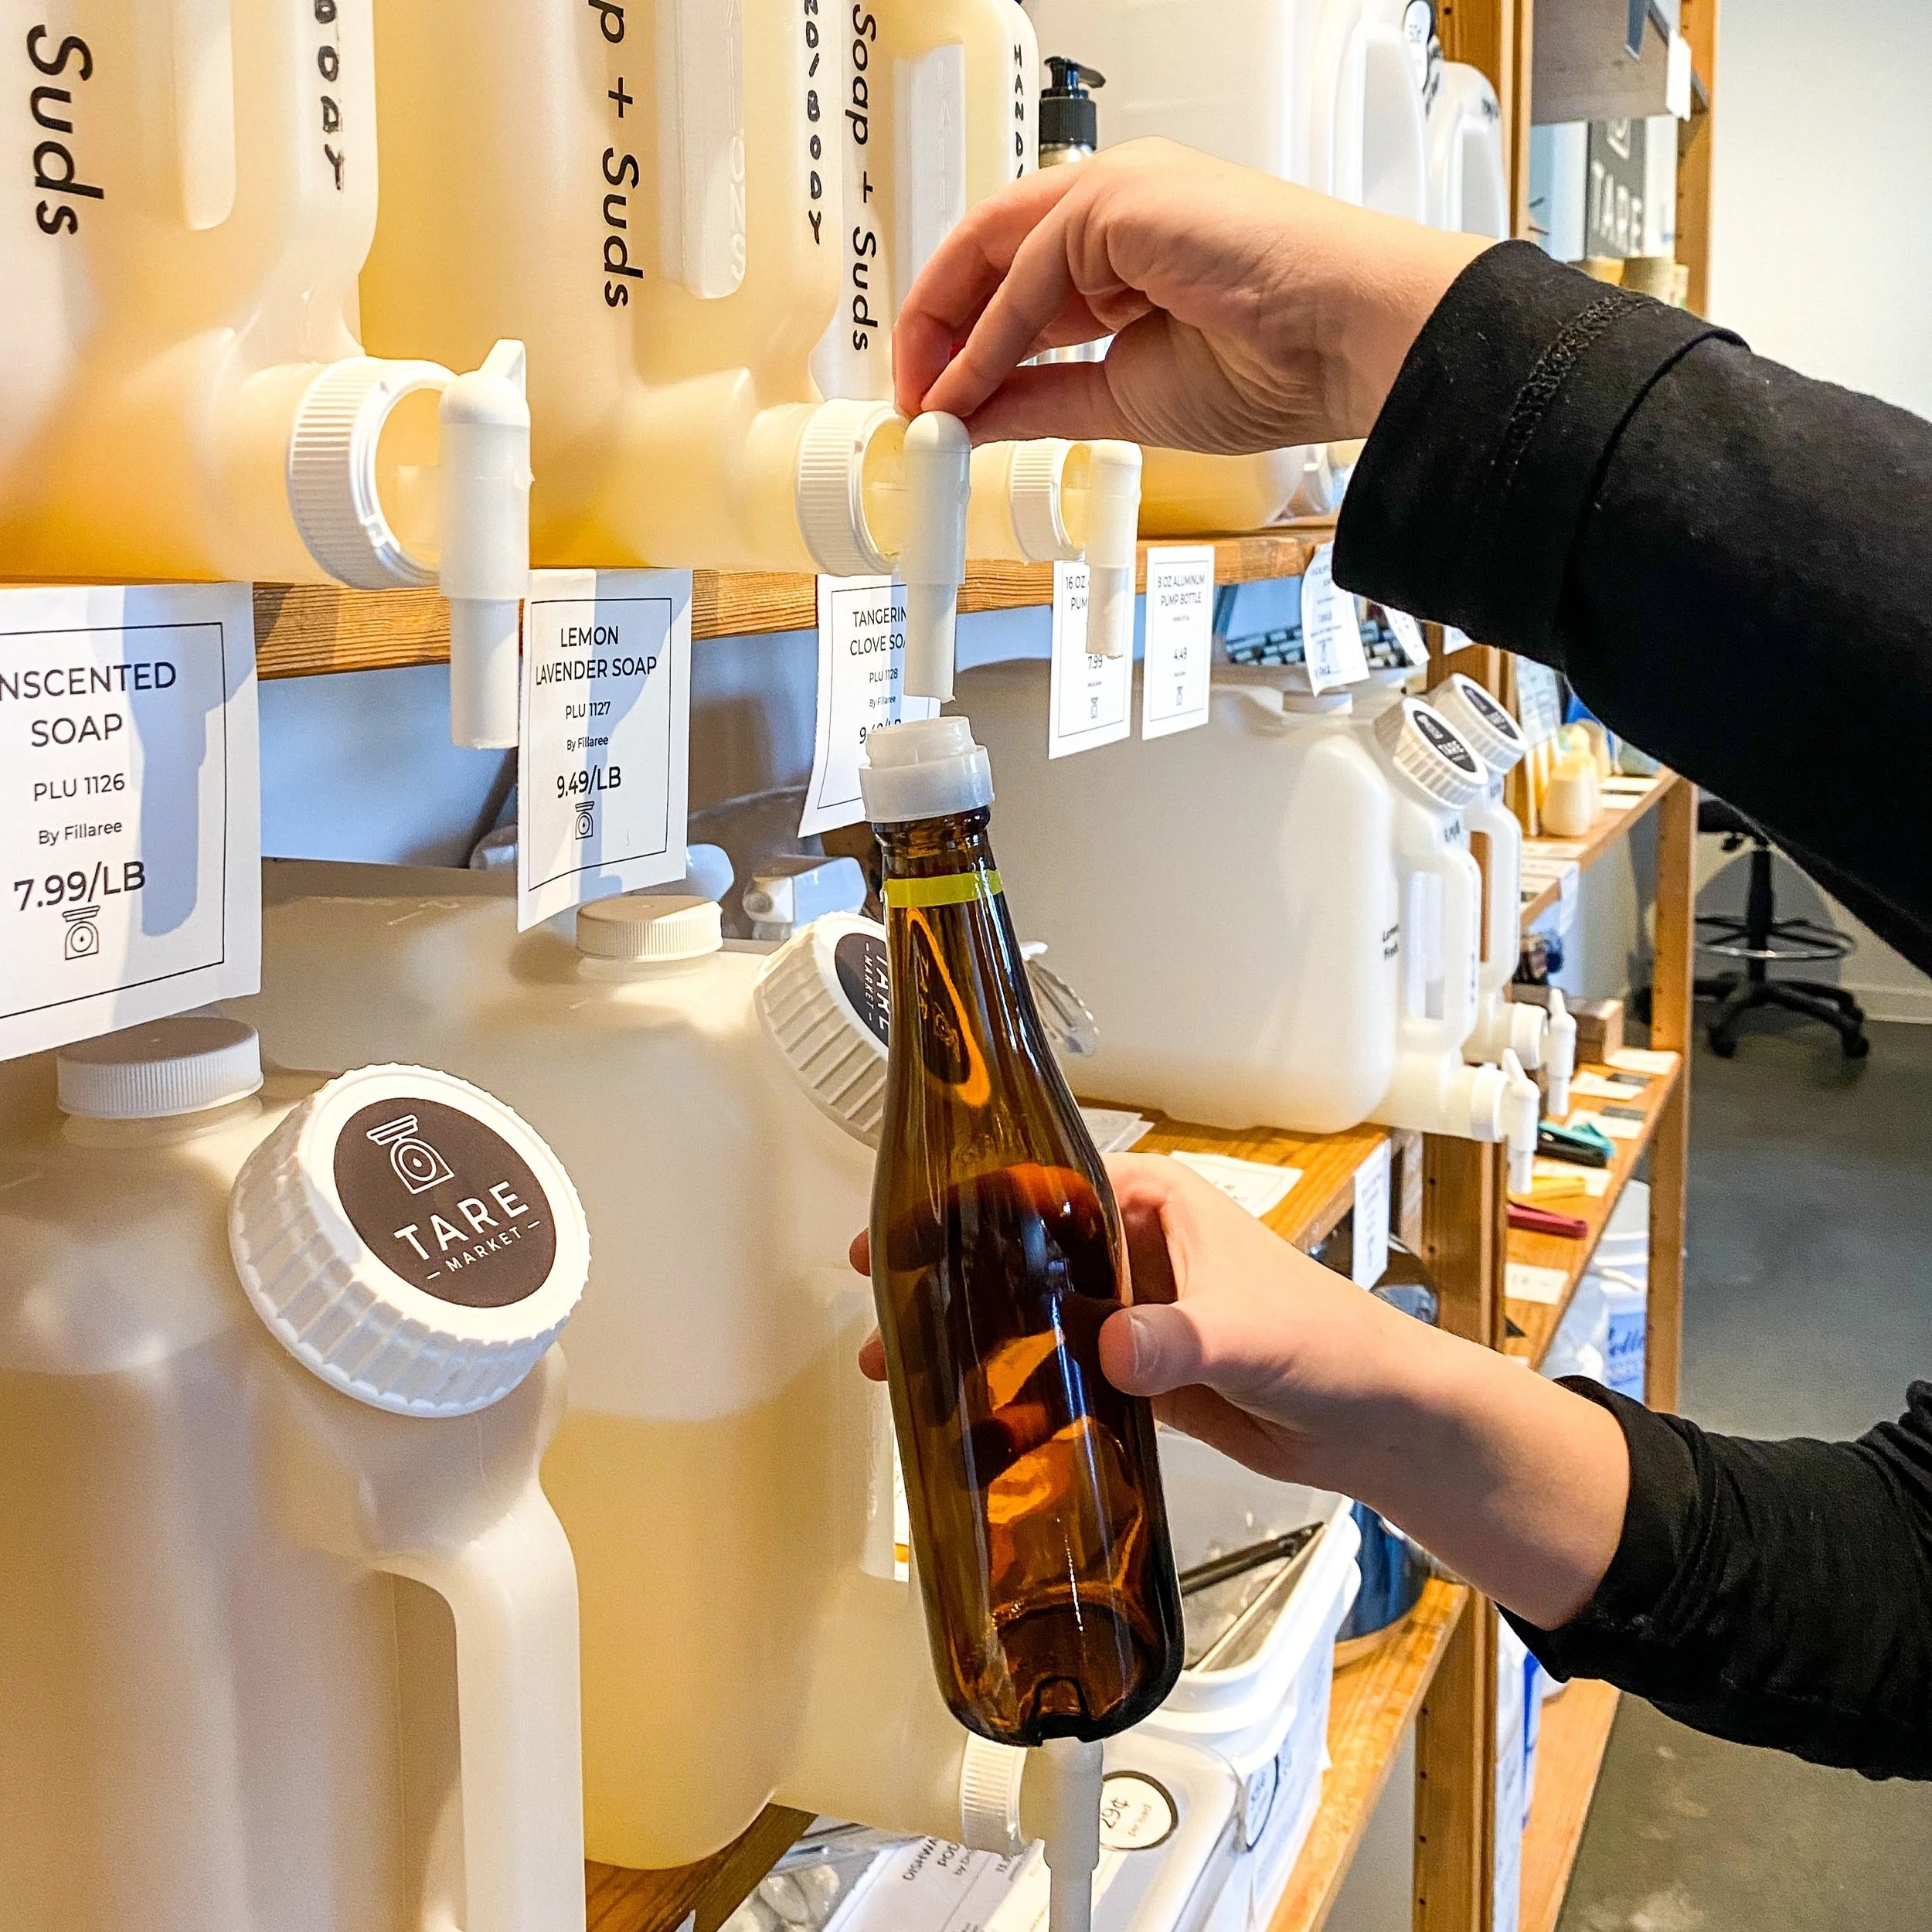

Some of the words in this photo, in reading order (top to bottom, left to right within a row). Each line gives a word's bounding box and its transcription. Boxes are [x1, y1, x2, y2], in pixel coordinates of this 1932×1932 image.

[845, 4, 877, 145] Soap
[27, 24, 104, 235] Suds
[602, 148, 644, 308] Suds
[852, 226, 879, 351] Suds
[1066, 577, 1073, 590] 16
[1076, 576, 1086, 589] OZ
[1163, 576, 1172, 588] OZ
[1173, 574, 1205, 587] ALUMINUM
[1070, 597, 1087, 611] PUM
[1161, 594, 1179, 607] PUMP
[1180, 592, 1202, 605] BOTTLE
[852, 606, 906, 628] TANGERIN
[561, 626, 619, 648] LEMON
[850, 636, 886, 656] CLOVE
[889, 633, 906, 651] SO
[536, 659, 608, 685] LAVENDER
[611, 656, 658, 677] SOAP
[869, 672, 883, 683] PLU
[885, 668, 899, 680] 1128
[1087, 655, 1104, 670] 7.99
[0, 662, 177, 701] NSCENTED
[566, 703, 586, 719] PLU
[589, 701, 611, 716] 1127
[31, 713, 123, 747] SOAP
[567, 740, 577, 752] By
[577, 736, 609, 748] Fillaree
[34, 778, 77, 801] PLU
[84, 773, 126, 794] 1126
[556, 765, 621, 798] 9.49/LB
[39, 830, 60, 845] By
[65, 821, 123, 840] Fillaree
[14, 861, 146, 911] 7.99/LB
[864, 954, 874, 1010] MARKET
[393, 1181, 529, 1260] TARE
[444, 1226, 522, 1272] MARKET
